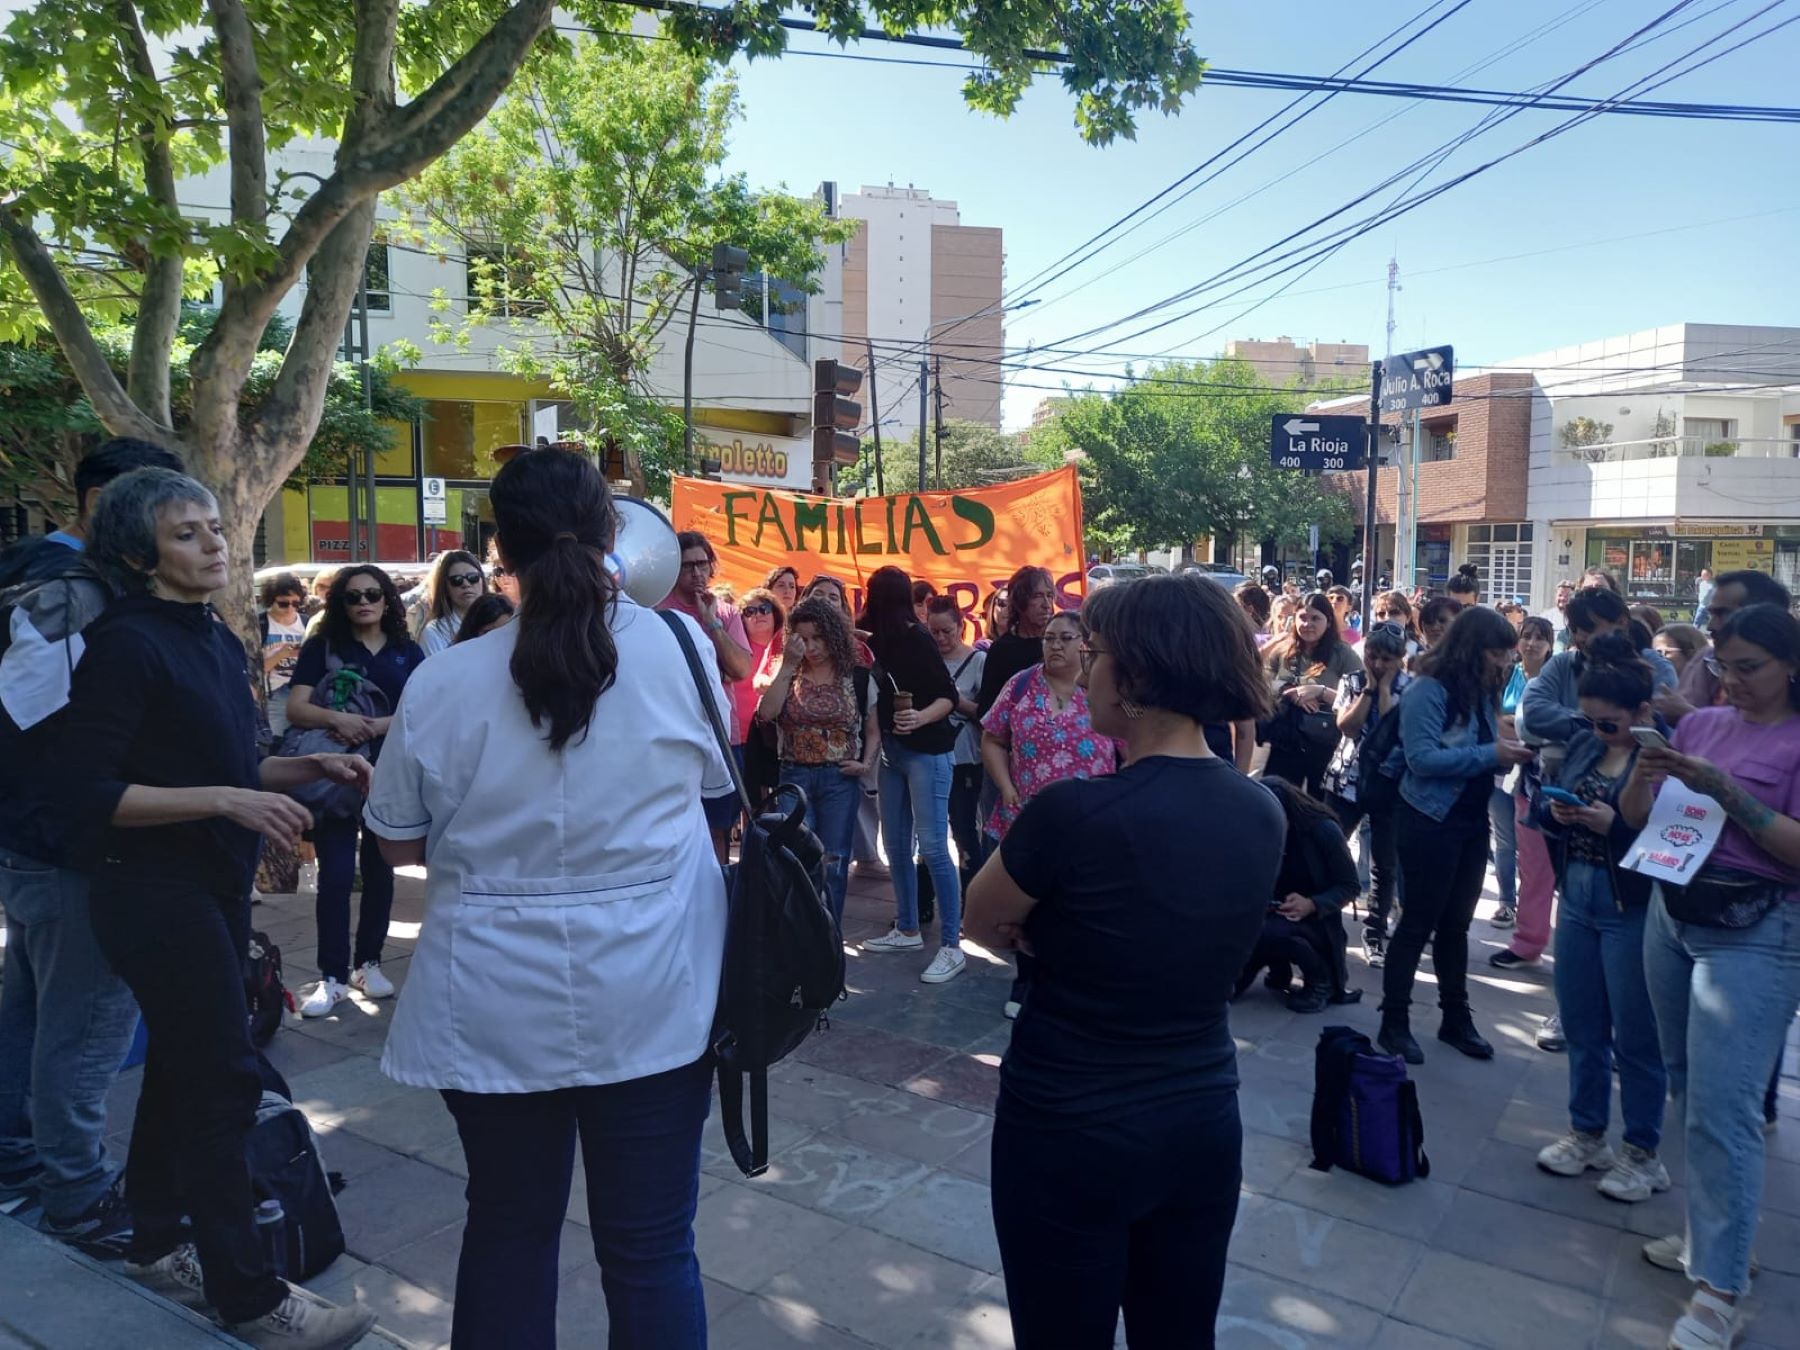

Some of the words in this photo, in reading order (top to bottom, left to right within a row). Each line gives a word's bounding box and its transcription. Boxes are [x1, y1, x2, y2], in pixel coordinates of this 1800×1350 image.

[1383, 376, 1407, 396] Julio
[1410, 374, 1421, 391] A.
[1423, 371, 1450, 389] Roca
[1390, 398, 1406, 410] 300
[1421, 393, 1439, 405] 400
[1289, 437, 1306, 452] La
[1310, 437, 1348, 454] Rioja
[1279, 456, 1301, 468] 400
[1322, 457, 1344, 469] 300
[721, 491, 995, 556] FAMILIAS
[319, 540, 367, 550] PIZZS
